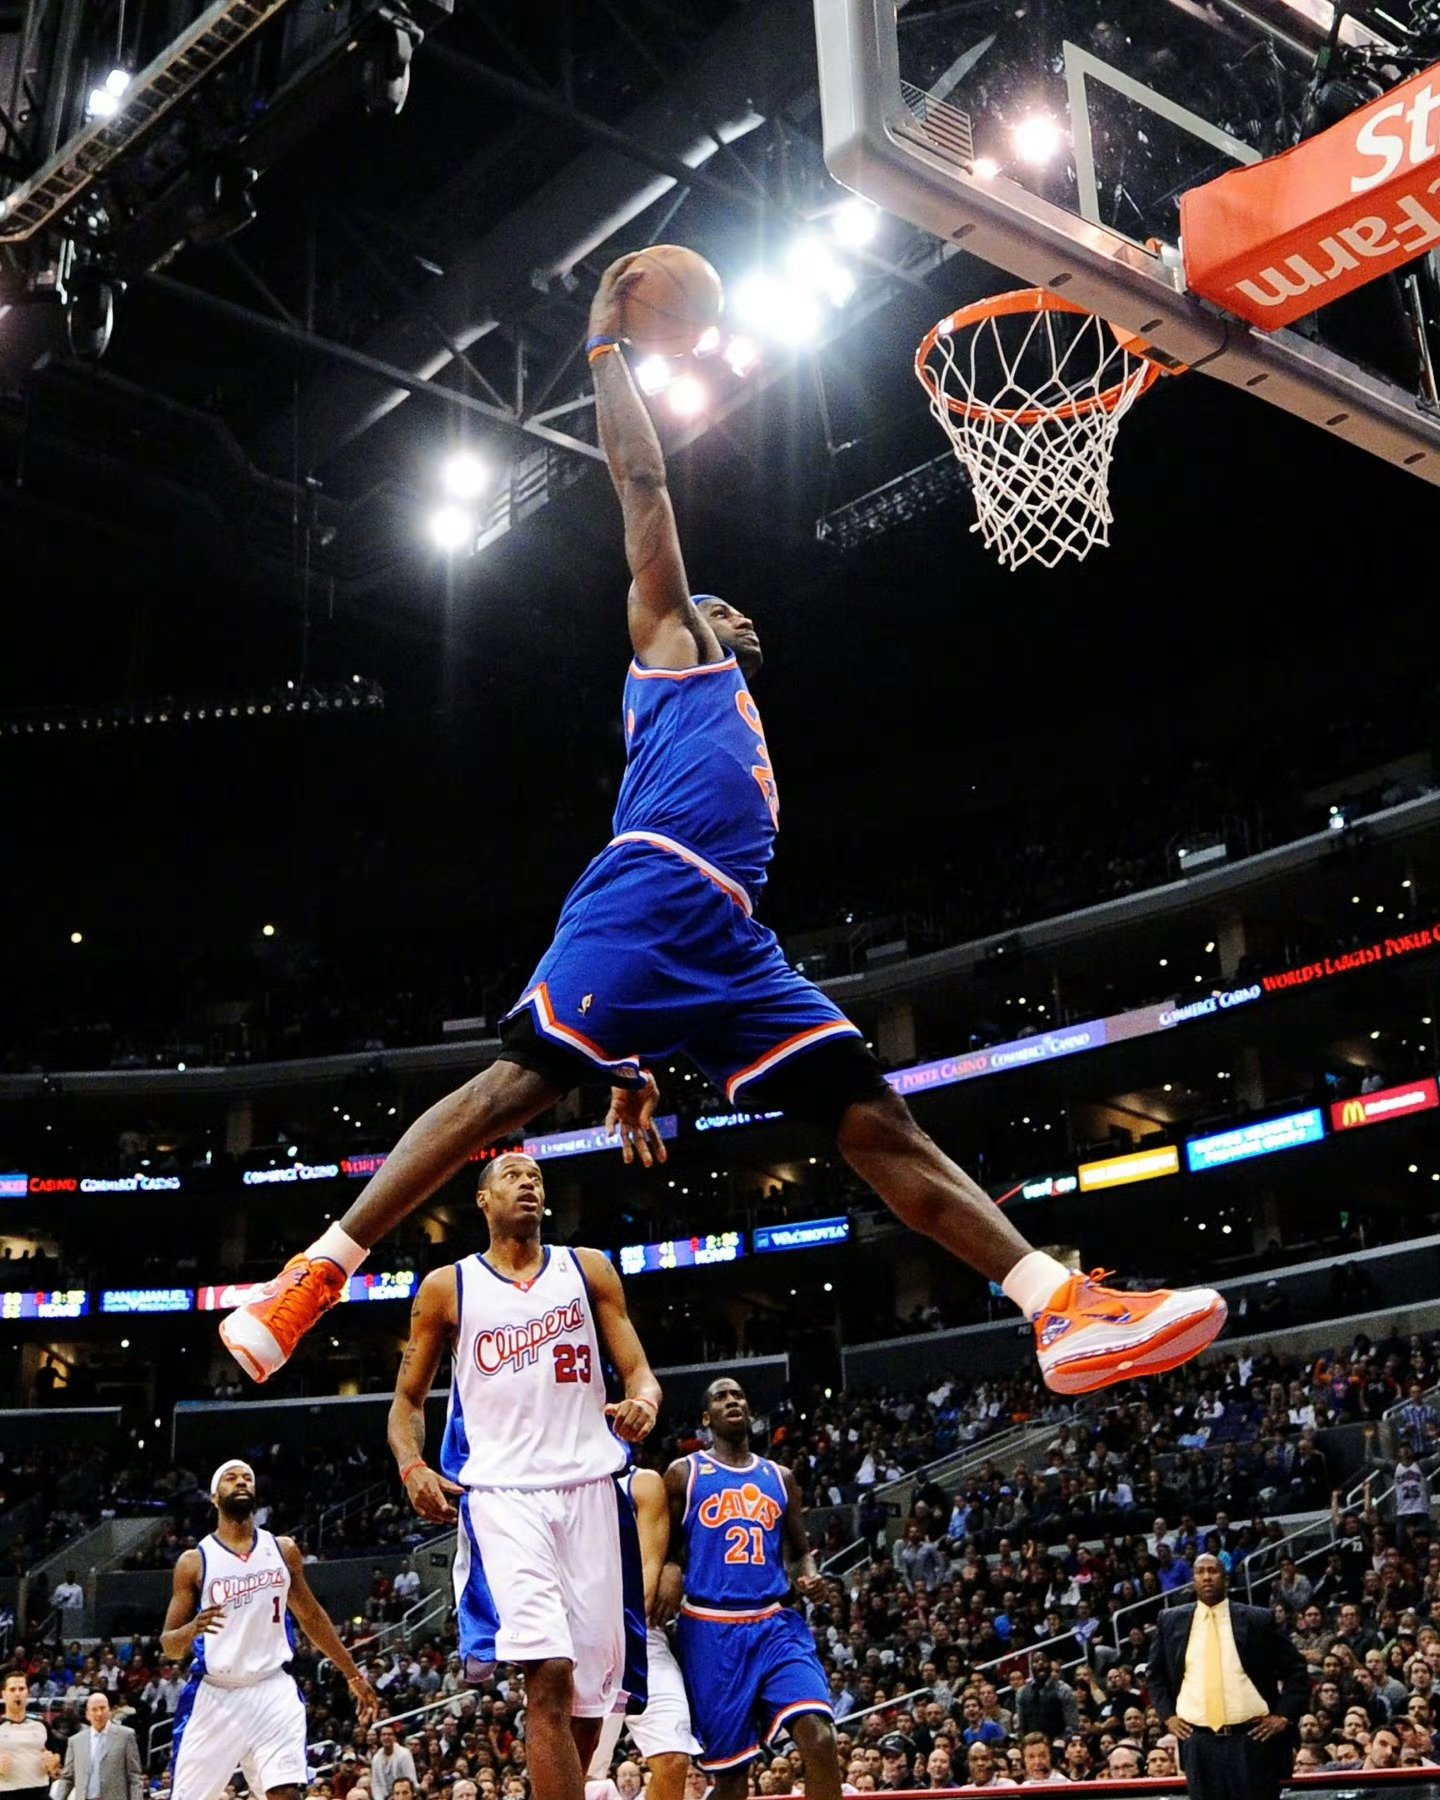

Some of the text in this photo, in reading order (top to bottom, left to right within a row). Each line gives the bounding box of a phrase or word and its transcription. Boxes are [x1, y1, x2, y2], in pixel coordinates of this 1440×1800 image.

[1235, 195, 1440, 306] Farm
[1262, 962, 1323, 991] WORLD'S
[1324, 944, 1382, 975] LARGEST
[1384, 930, 1432, 957] POKER
[941, 1056, 987, 1078] CASINO
[30, 1178, 77, 1192] CASINO
[771, 1226, 845, 1246] WACHOVIA
[474, 1298, 584, 1376] Clippers
[553, 1344, 591, 1383] 23
[698, 1483, 782, 1531] CAVS
[724, 1526, 766, 1565] 21
[210, 1568, 284, 1609] Clippers
[272, 1596, 280, 1623] 1
